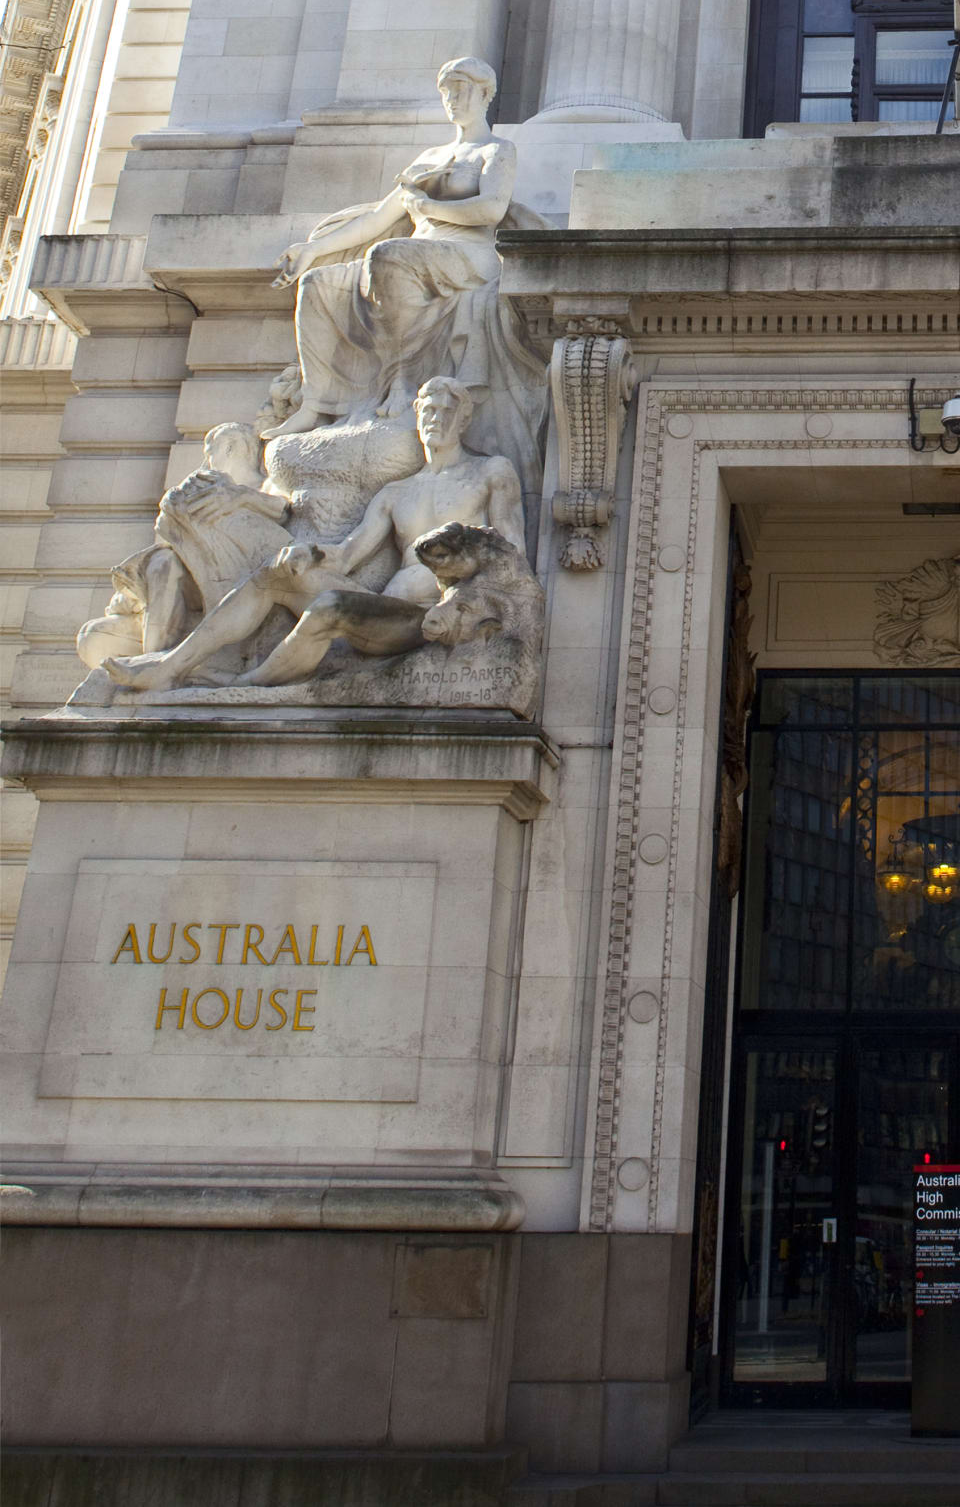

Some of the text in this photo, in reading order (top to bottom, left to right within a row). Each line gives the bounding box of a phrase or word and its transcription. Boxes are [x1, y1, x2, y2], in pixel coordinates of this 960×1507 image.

[400, 666, 513, 685] HAROLD PARKER
[110, 923, 378, 966] AUSTRALIA
[155, 987, 318, 1031] HOUSE
[916, 1191, 944, 1206] High
